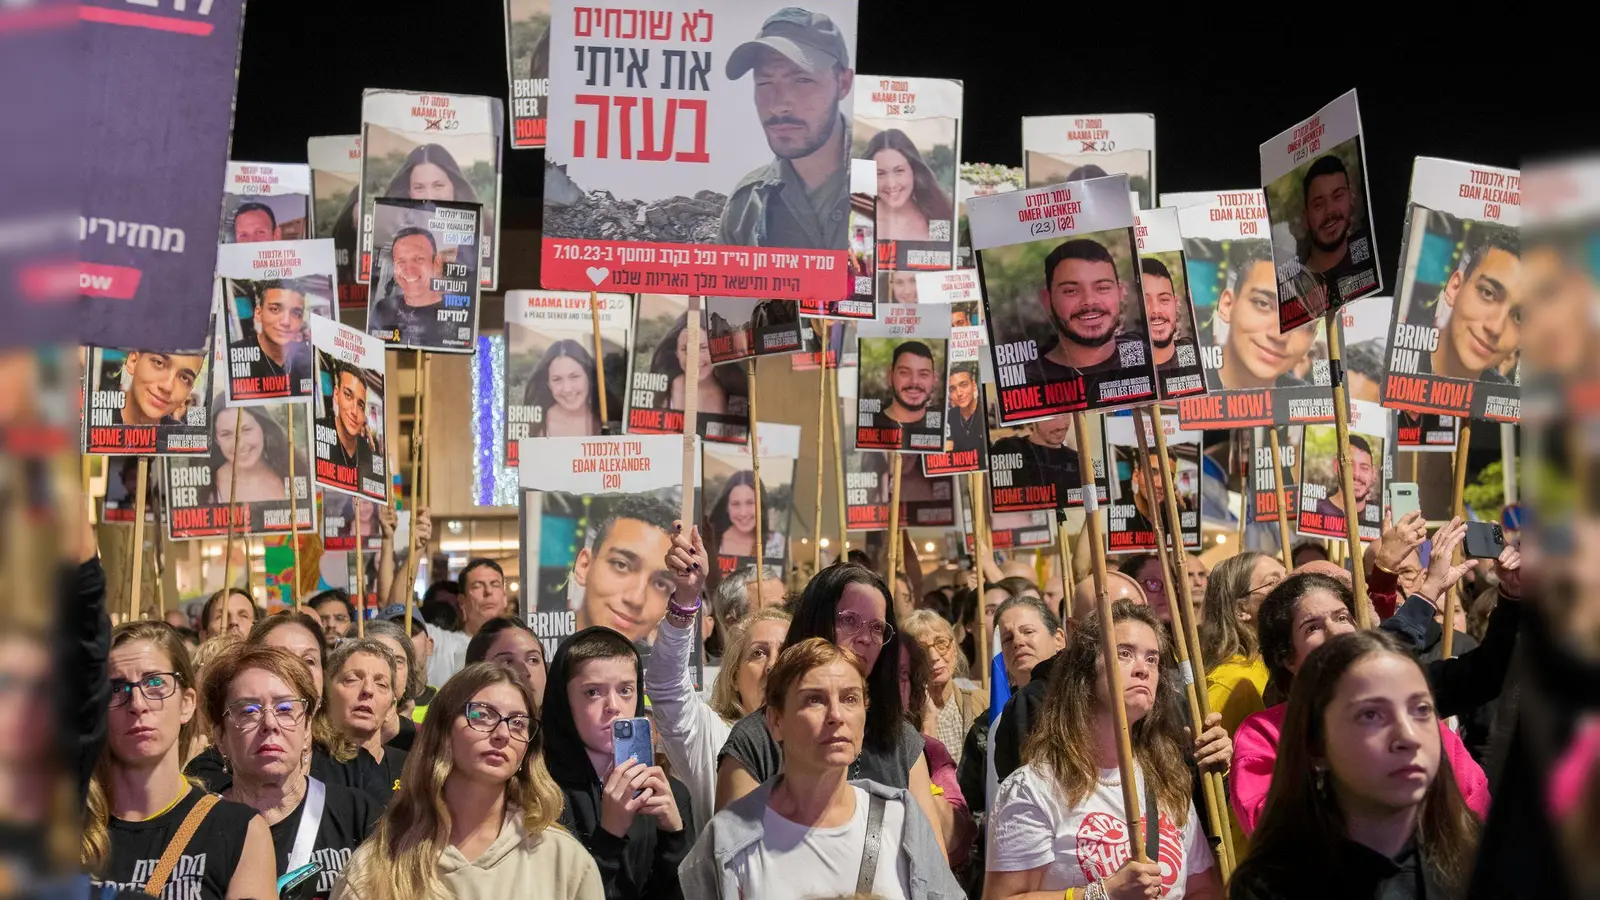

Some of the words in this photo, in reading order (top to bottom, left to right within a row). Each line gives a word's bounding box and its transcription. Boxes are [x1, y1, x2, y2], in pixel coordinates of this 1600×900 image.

[573, 7, 672, 40] שוכחים
[681, 9, 714, 42] לא
[574, 46, 650, 88] איתי
[661, 51, 712, 91] את
[872, 92, 897, 103] NAAMA
[898, 92, 916, 104] LEVY
[411, 106, 438, 118] NAAMA
[439, 108, 457, 120] LEVY
[515, 98, 539, 116] HER
[444, 120, 460, 130] 20
[573, 95, 711, 163] בעזה
[1067, 131, 1092, 140] NAAMA
[1093, 130, 1110, 140] LEVY
[1100, 140, 1116, 151] 20
[1293, 146, 1309, 164] (23)
[1470, 169, 1504, 187] אלכסנדר
[1025, 192, 1049, 208] ונקרט
[1051, 189, 1073, 204] עומר
[1216, 193, 1254, 207] אלכסנדר
[1459, 183, 1482, 201] EDAN
[1018, 207, 1043, 223] OMER
[1043, 200, 1082, 220] WENKERT
[1210, 208, 1233, 222] EDAN
[1483, 204, 1501, 220] (20)
[1030, 219, 1056, 236] (23)
[1239, 220, 1258, 235] (20)
[252, 259, 269, 270] EDAN
[270, 258, 302, 269] ALEXANDER
[616, 246, 656, 265] ונחטף
[660, 249, 690, 267] בקרב
[694, 248, 717, 266] נפל
[752, 253, 768, 270] חן
[771, 252, 798, 269] איתי
[264, 268, 280, 279] (20)
[612, 269, 641, 286] שלנו
[645, 271, 689, 288] האריות
[694, 273, 717, 290] מלך
[723, 275, 769, 292] ותישאר
[775, 277, 801, 293] היית
[528, 297, 562, 309] NAAMA
[564, 298, 587, 309] LEVY
[528, 311, 546, 319] PEACE
[547, 312, 568, 320] SEEKER
[568, 313, 580, 321] AND
[1394, 324, 1439, 352] BRING
[231, 347, 260, 363] BRING
[995, 340, 1038, 366] BRING
[232, 362, 251, 377] HIM
[1390, 349, 1421, 375] HIM
[232, 376, 261, 394] HOME
[262, 373, 291, 393] NOW!
[633, 373, 669, 392] BRING
[998, 366, 1026, 388] HIM
[1099, 380, 1121, 392] HOSTAGES
[1121, 378, 1133, 388] AND
[1133, 375, 1150, 387] MISSING
[1004, 386, 1043, 412] HOME
[1044, 376, 1086, 406] NOW!
[1100, 385, 1127, 400] FAMILIES
[1127, 382, 1152, 397] FORUM
[1167, 383, 1184, 395] FAMILIES
[1185, 380, 1203, 392] FORUM
[1386, 375, 1429, 404] HOME
[1430, 379, 1474, 410] NOW!
[91, 390, 126, 409] BRING
[632, 390, 654, 409] HER
[859, 398, 881, 413] BRING
[1180, 394, 1225, 421] HOME
[1226, 391, 1272, 418] NOW!
[1312, 398, 1323, 406] AND
[91, 408, 113, 426] HIM
[508, 405, 542, 423] BRING
[1288, 405, 1320, 417] FAMILIES
[1485, 402, 1512, 416] FAMILIES
[630, 409, 662, 429] HOME
[859, 412, 874, 427] HIM
[90, 427, 121, 447] HOME
[123, 426, 157, 447] NOW!
[316, 424, 338, 446] BRING
[508, 423, 529, 441] HER
[858, 427, 880, 444] HOME
[880, 427, 903, 444] NOW!
[1398, 426, 1420, 440] NOW!
[316, 440, 331, 460] HIM
[581, 441, 620, 457] אלכסנדר
[623, 442, 642, 458] עידן
[572, 459, 596, 474] EDAN
[599, 457, 651, 473] ALEXANDER
[927, 453, 951, 468] HOME
[952, 449, 979, 466] NOW!
[991, 453, 1024, 471] BRING
[171, 465, 211, 487] BRING
[316, 460, 337, 481] HOME
[337, 466, 359, 486] NOW!
[602, 474, 621, 489] (20)
[847, 472, 879, 488] BRING
[992, 470, 1013, 487] HIM
[172, 487, 199, 508] HER
[847, 487, 867, 504] HER
[993, 486, 1024, 504] HOME
[1025, 483, 1056, 503] NOW!
[1302, 482, 1327, 501] BRING
[1110, 504, 1136, 520] BRING
[1301, 497, 1317, 512] HIM
[173, 508, 210, 530] HOME
[212, 504, 251, 527] NOW!
[848, 505, 876, 522] HOME
[1300, 511, 1322, 529] HOME
[1323, 514, 1348, 532] NOW!
[1110, 518, 1127, 532] HIM
[1110, 531, 1134, 546] HOME
[528, 611, 577, 637] BRING
